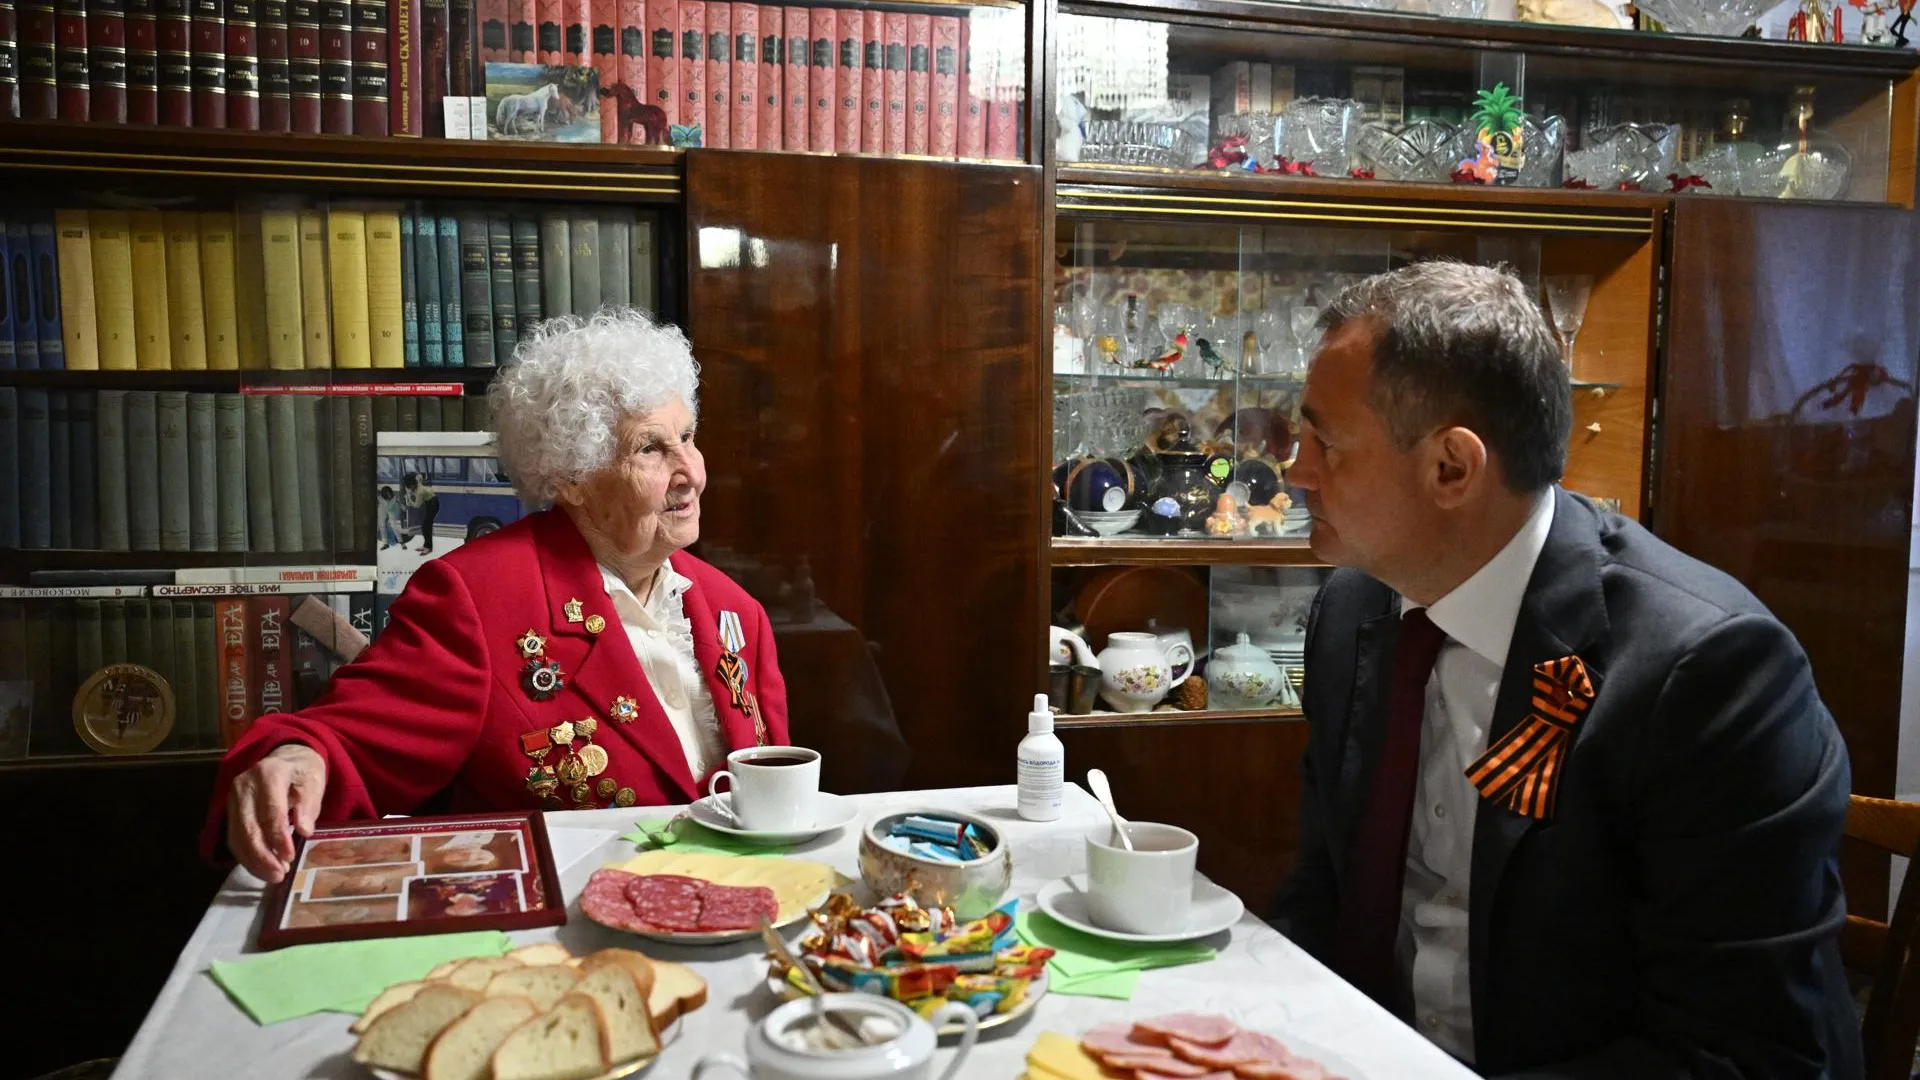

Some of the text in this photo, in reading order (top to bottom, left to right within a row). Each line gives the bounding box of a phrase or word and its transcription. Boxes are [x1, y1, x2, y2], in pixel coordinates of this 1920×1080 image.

[299, 37, 309, 46] 10
[366, 41, 376, 50] 12
[11, 588, 90, 597] МОСКОВСКИЕ
[160, 585, 281, 595] ИМЯ ТВОЕ БЕССМЕРТНО
